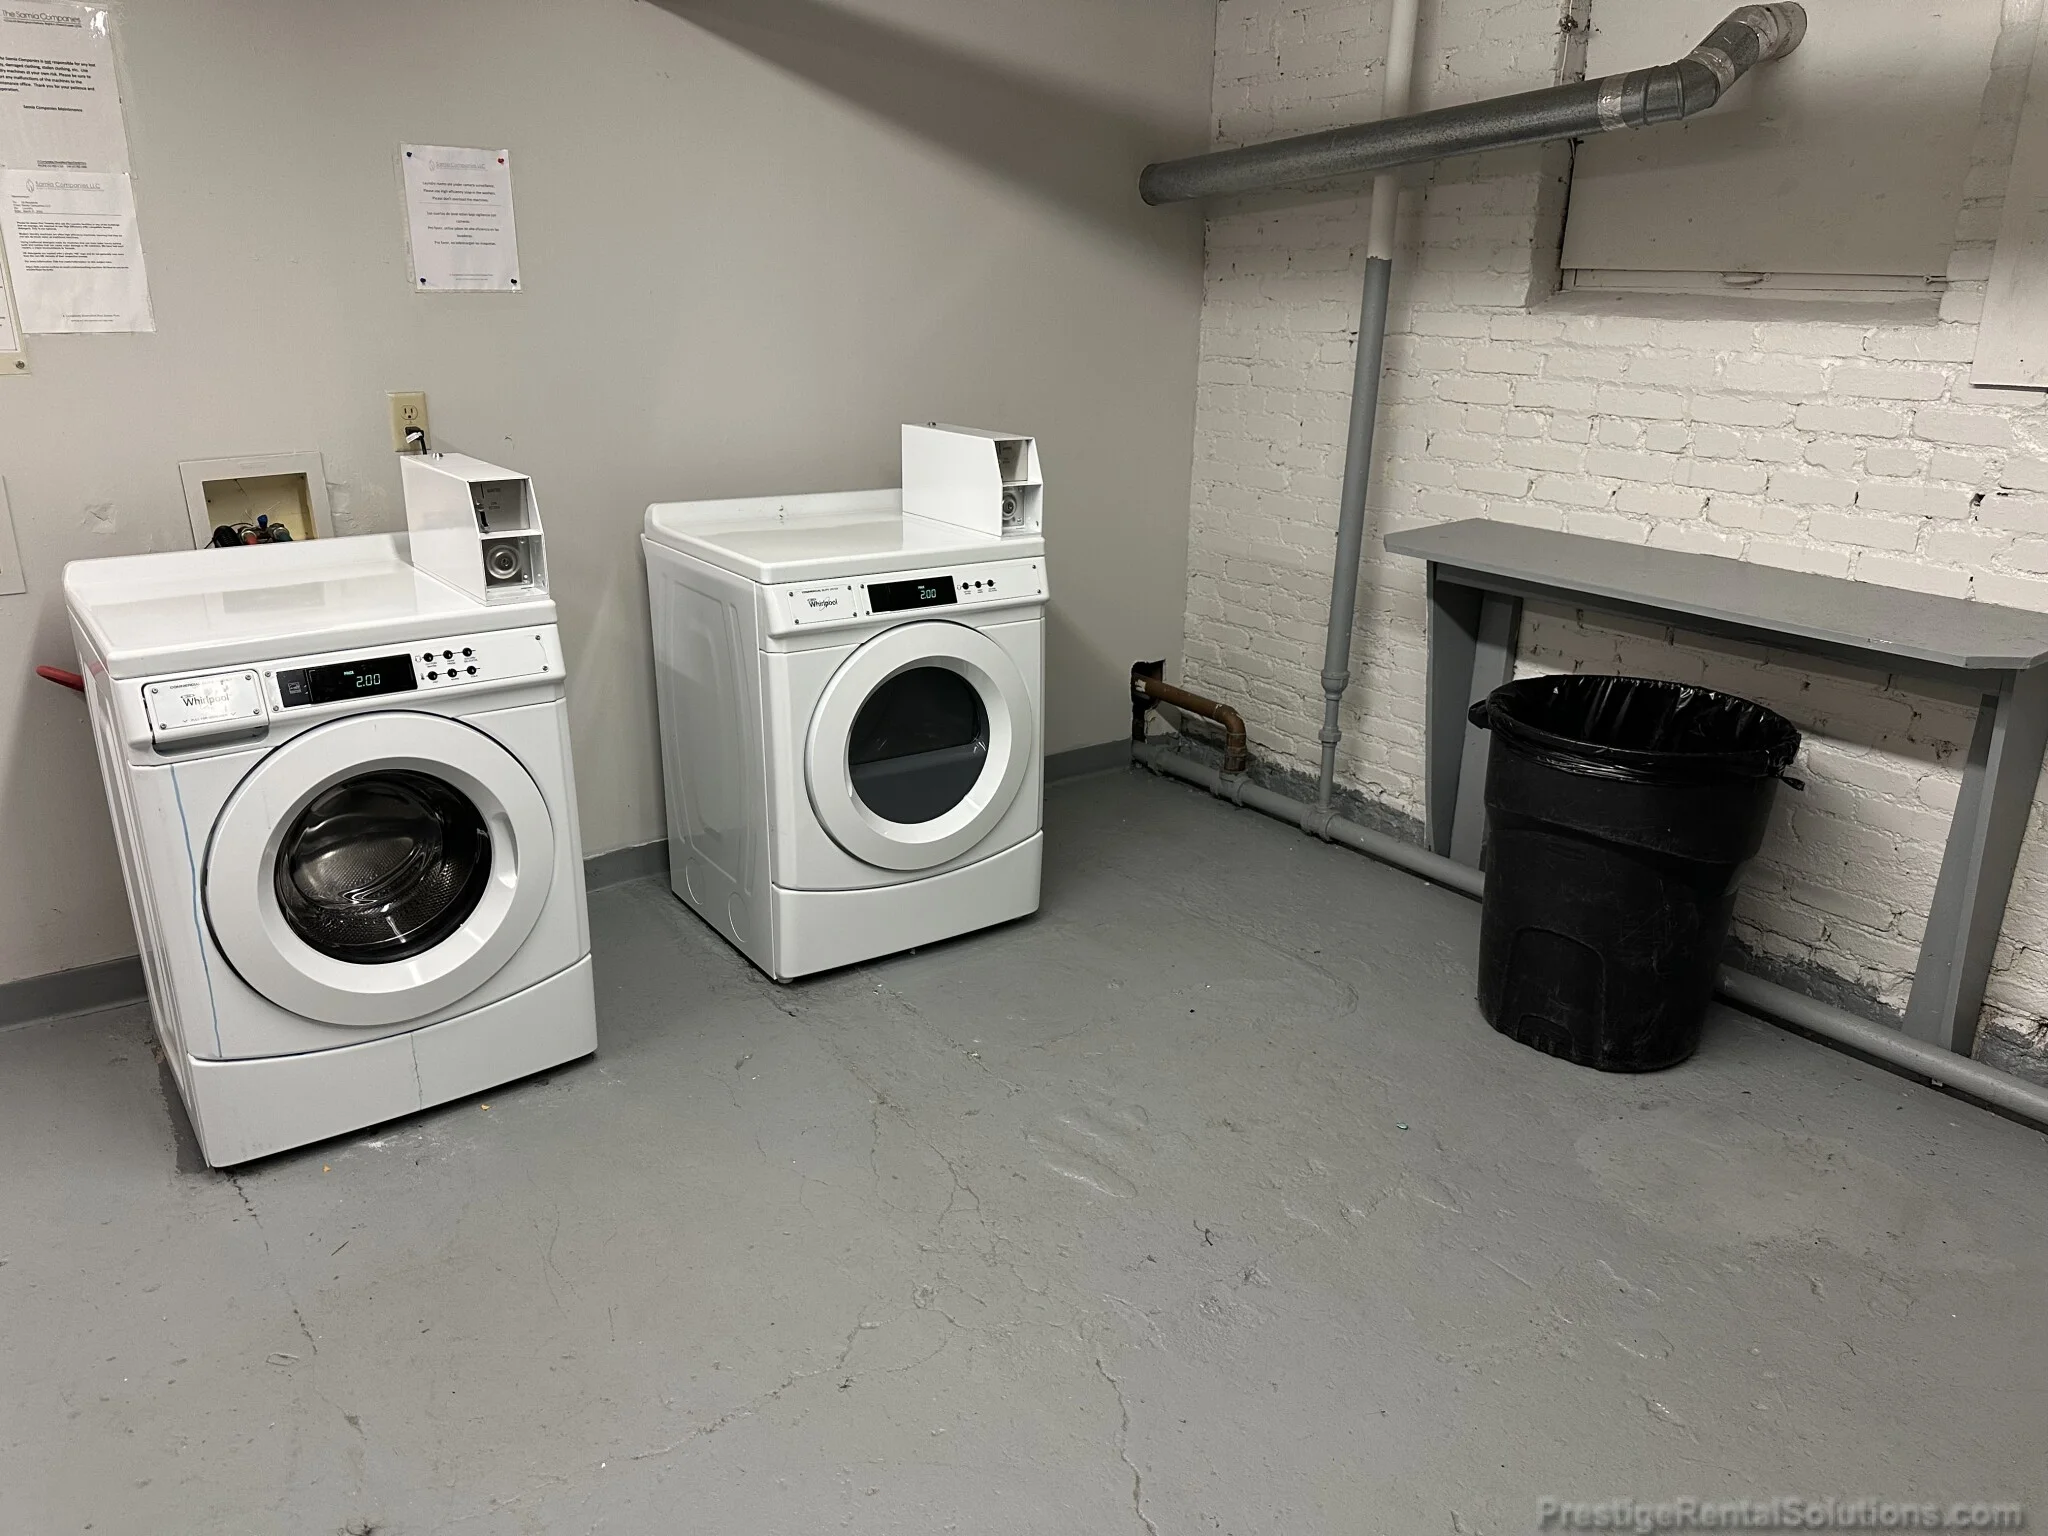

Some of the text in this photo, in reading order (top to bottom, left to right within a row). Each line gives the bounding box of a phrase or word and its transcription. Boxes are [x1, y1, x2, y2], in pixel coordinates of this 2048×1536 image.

[920, 589, 936, 599] 2.00
[809, 598, 838, 608] Whirlpool
[356, 673, 381, 687] 2.00
[182, 693, 229, 706] Whirlpool
